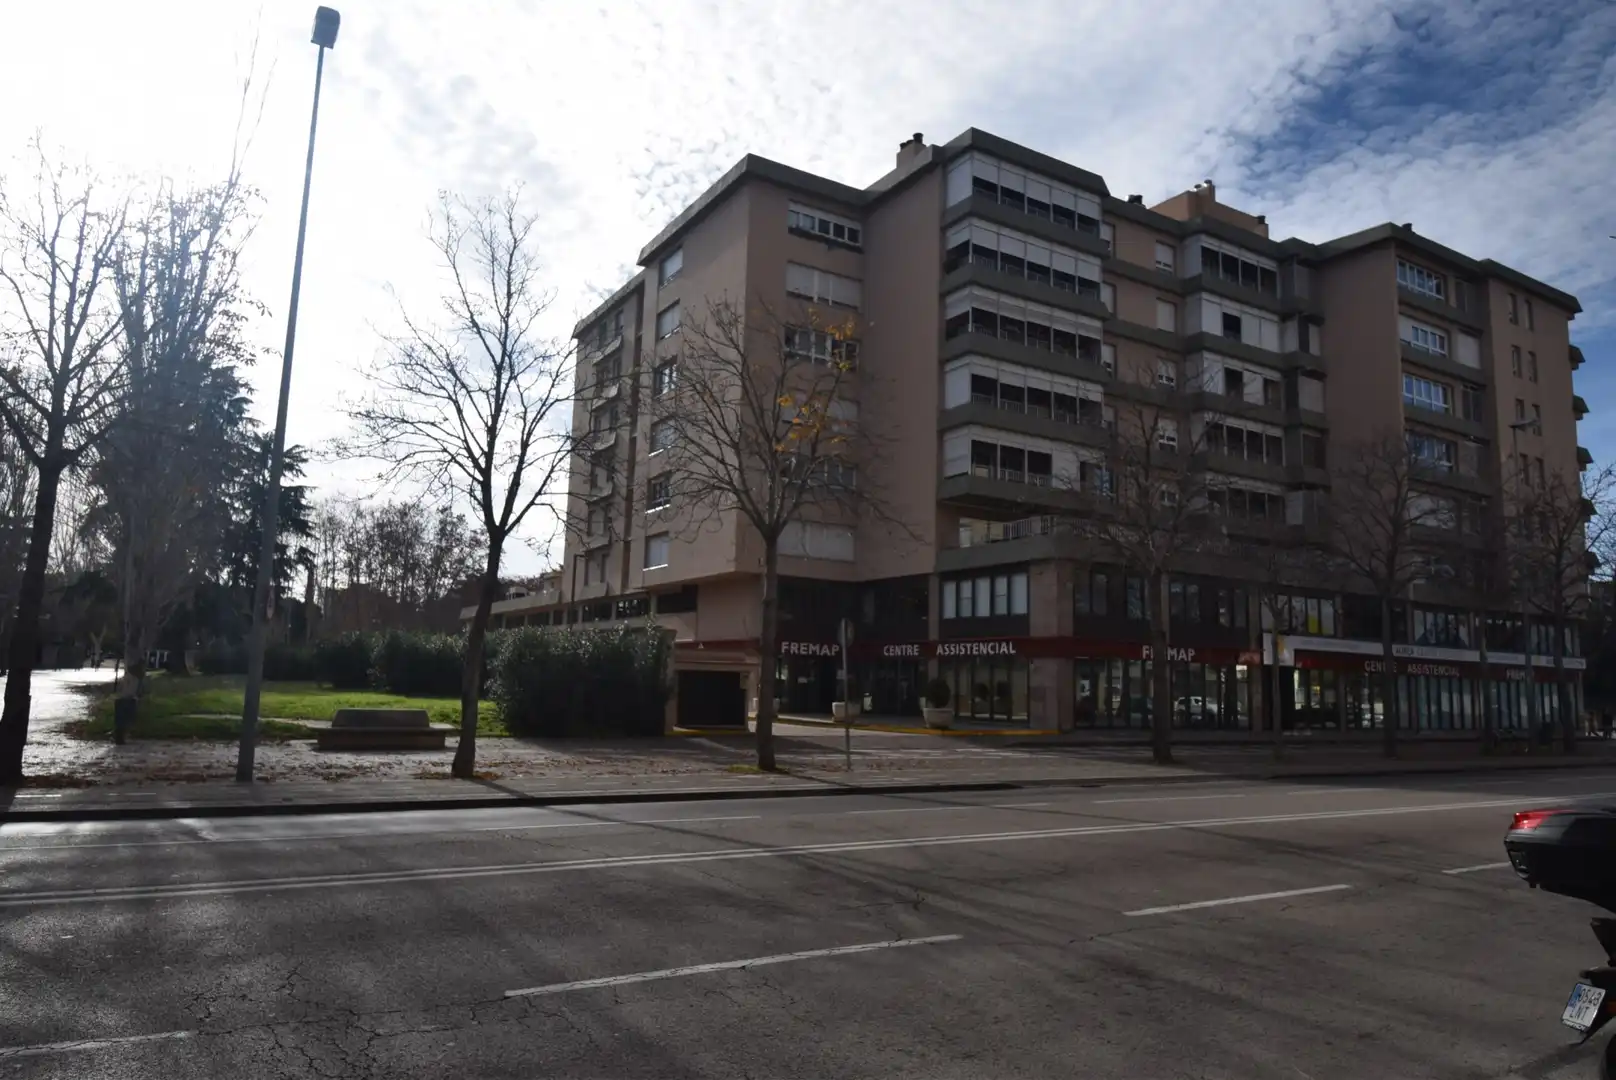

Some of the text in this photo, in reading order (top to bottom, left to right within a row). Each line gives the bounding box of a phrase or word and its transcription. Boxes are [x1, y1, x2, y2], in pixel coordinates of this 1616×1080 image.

[781, 641, 1017, 657] FREMAP CENTRE ASSISTENCIAL
[1142, 644, 1196, 661] FMAP
[1407, 663, 1460, 677] ASSISTENCIAL
